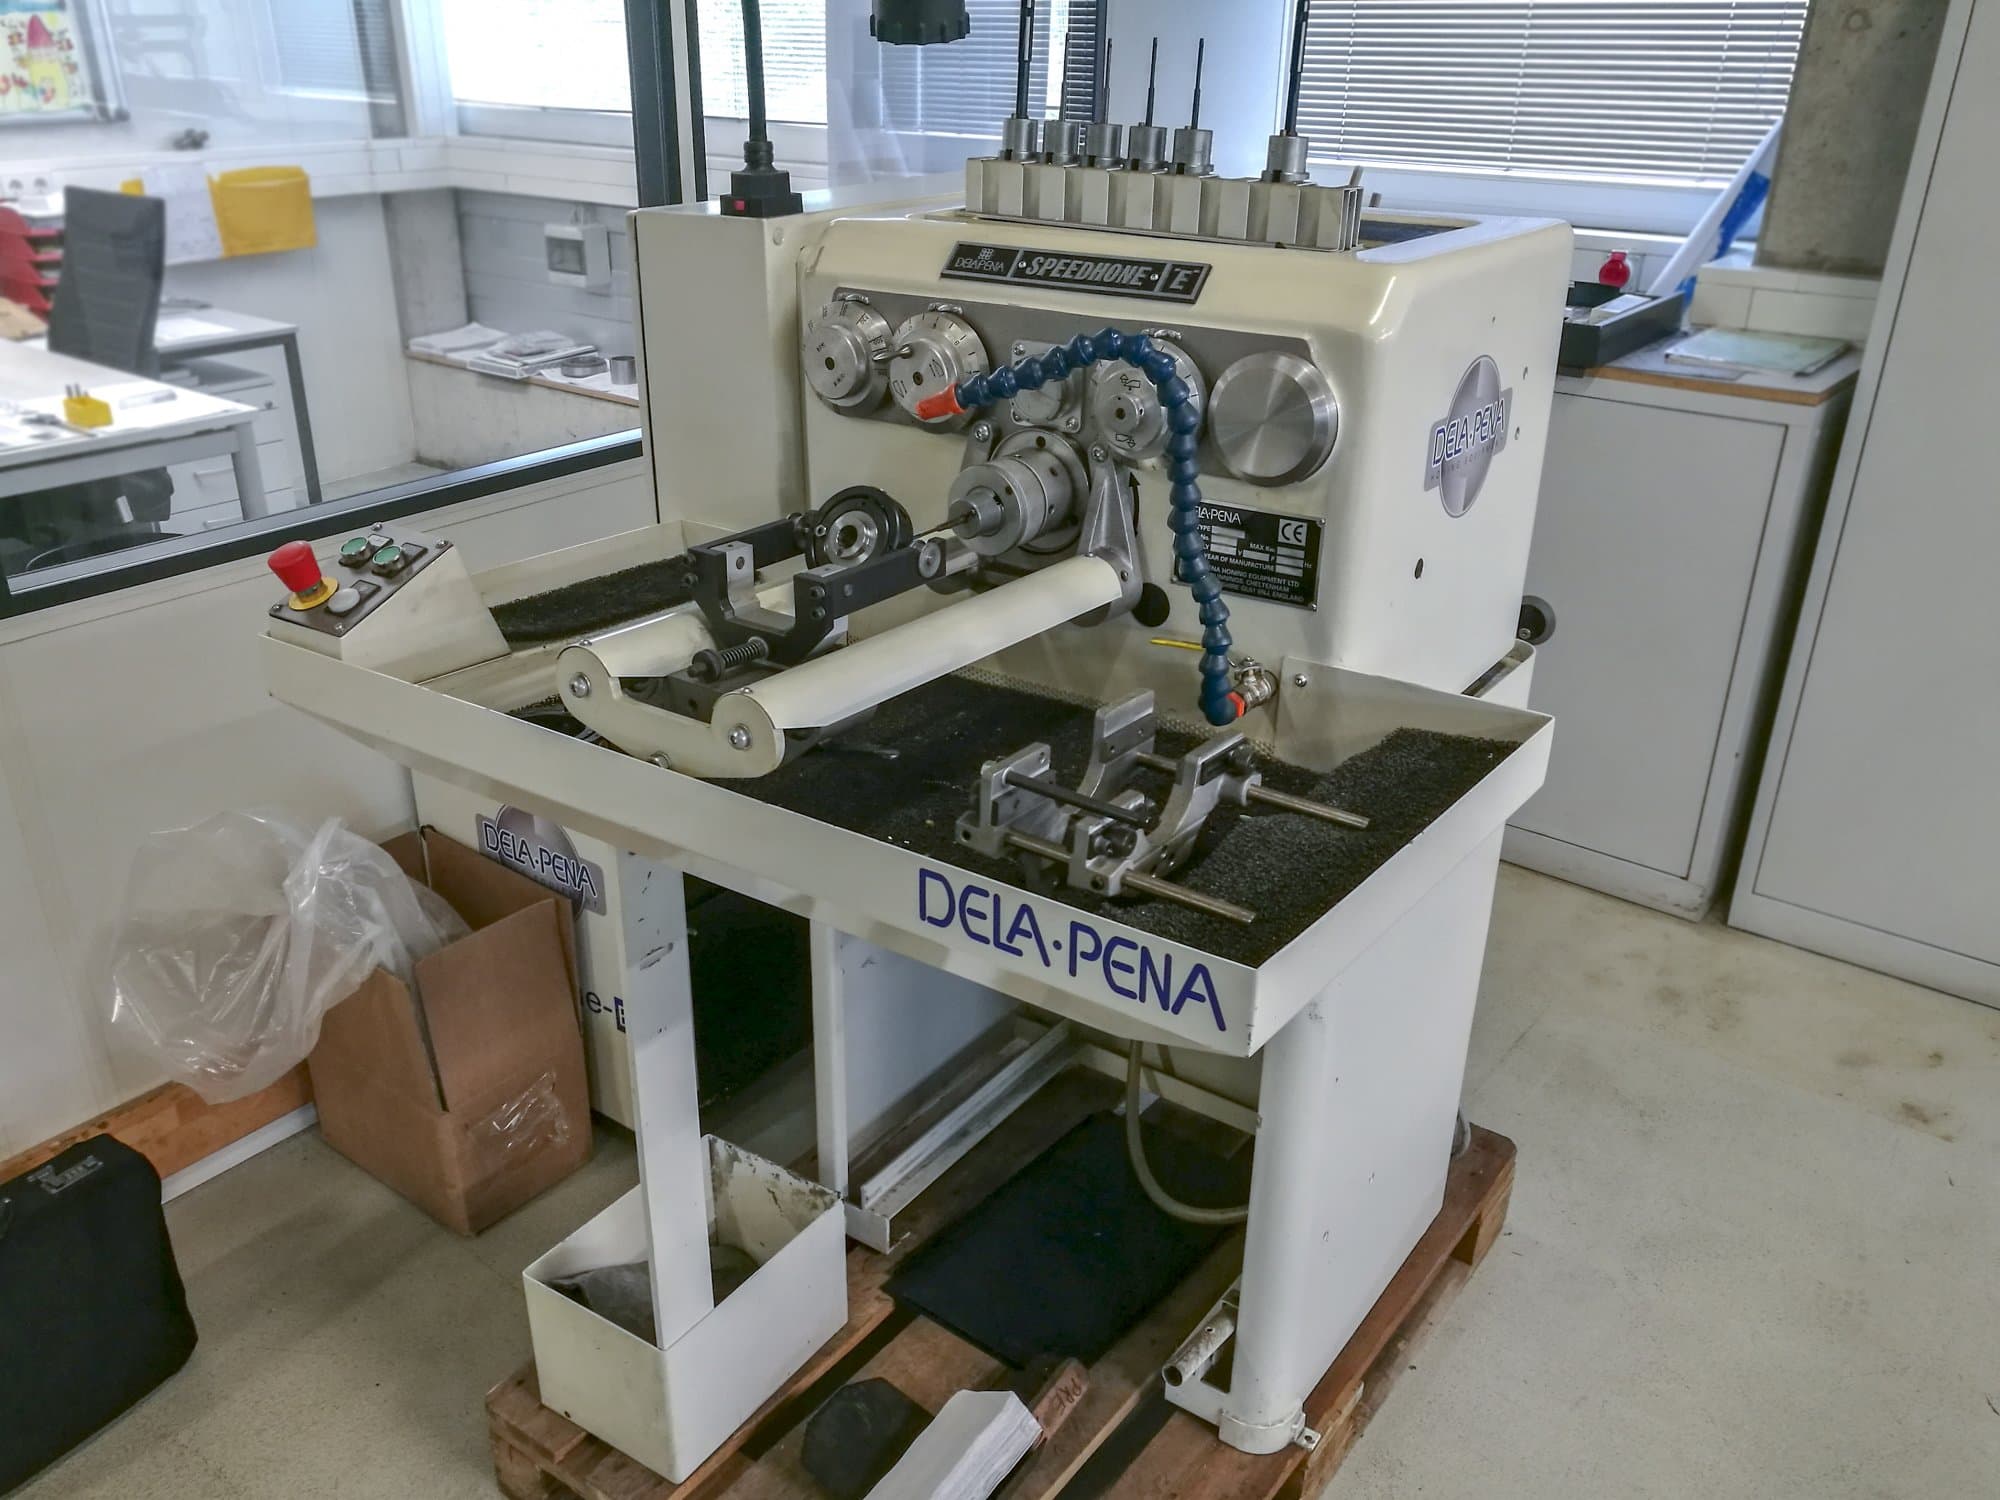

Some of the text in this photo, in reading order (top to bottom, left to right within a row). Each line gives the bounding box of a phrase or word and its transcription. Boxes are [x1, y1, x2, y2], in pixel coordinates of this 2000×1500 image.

[1026, 256, 1152, 287] SPEEDHONE
[1229, 558, 1275, 572] MANUFACTURE
[1248, 573, 1286, 586] EQUIPMENT
